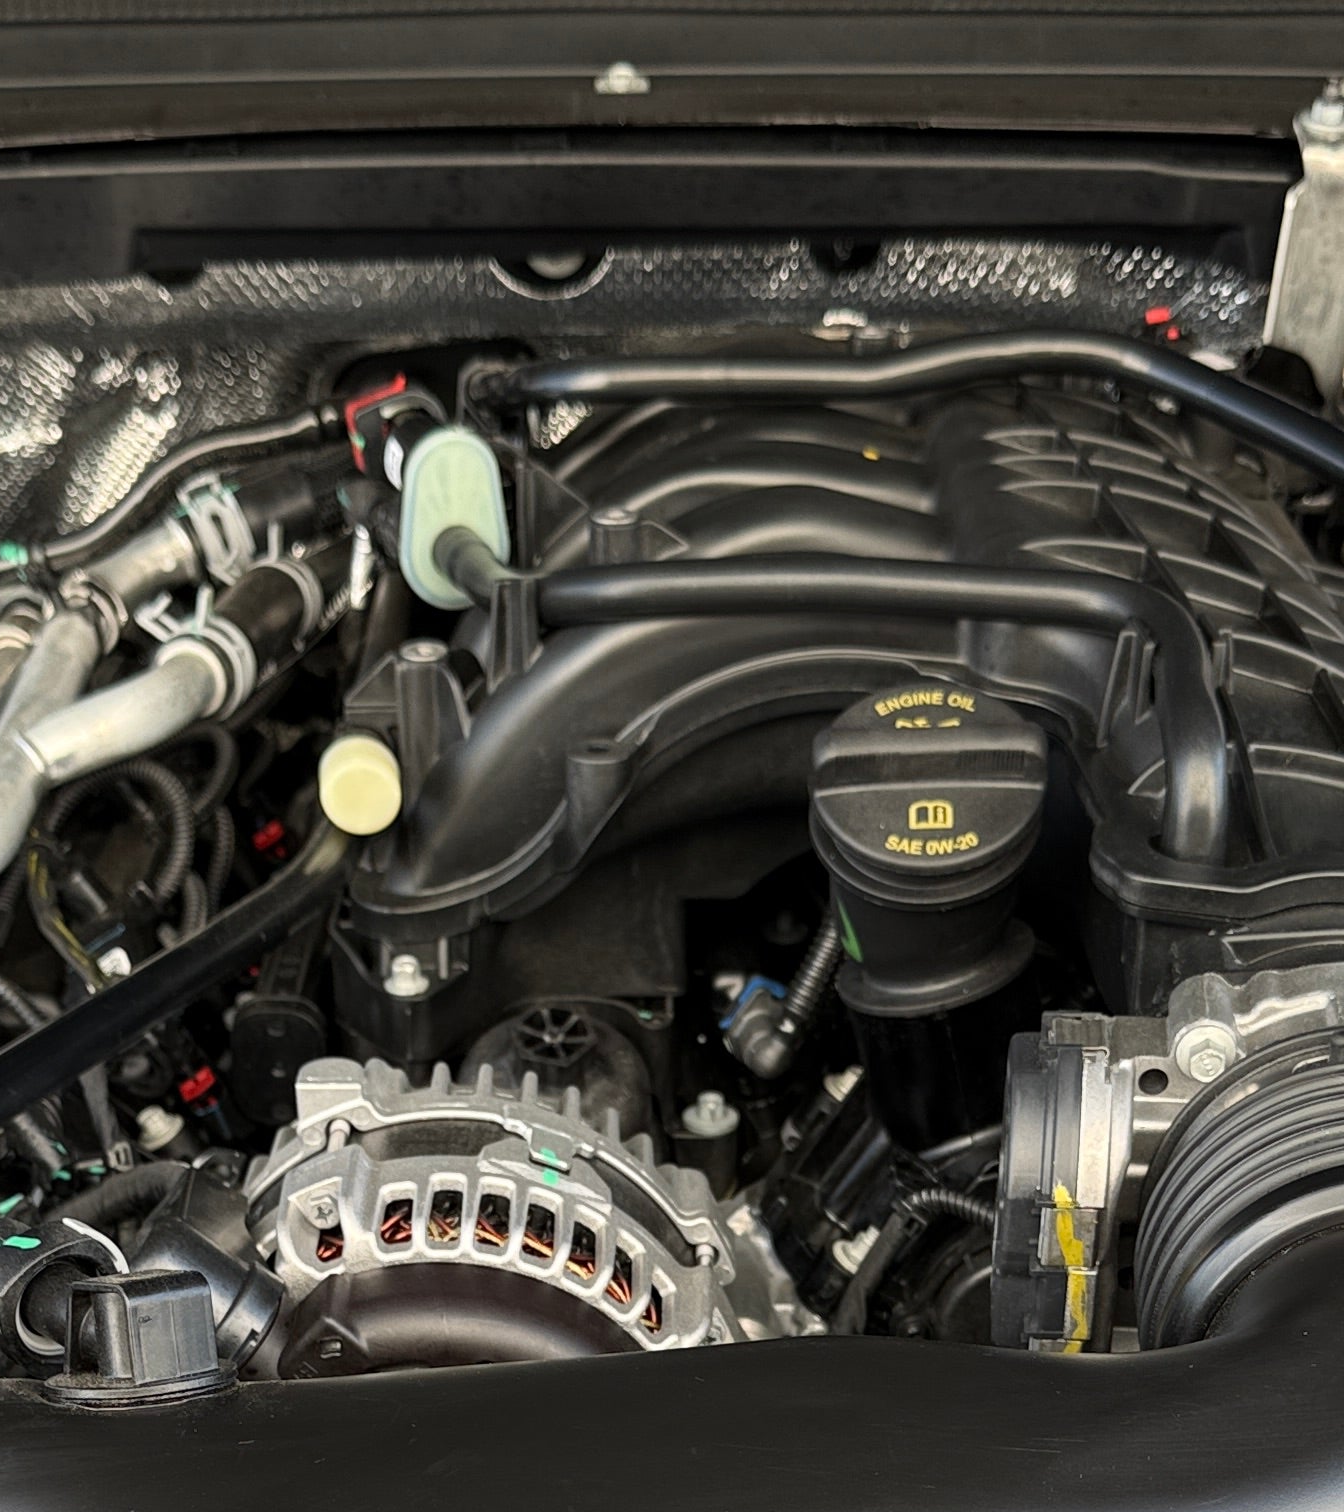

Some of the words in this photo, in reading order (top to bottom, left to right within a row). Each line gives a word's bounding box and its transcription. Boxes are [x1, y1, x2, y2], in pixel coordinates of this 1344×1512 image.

[874, 690, 944, 717] ENGINE
[947, 692, 976, 713] OIL
[885, 834, 923, 856] SAE
[925, 831, 979, 856] 0W-20
